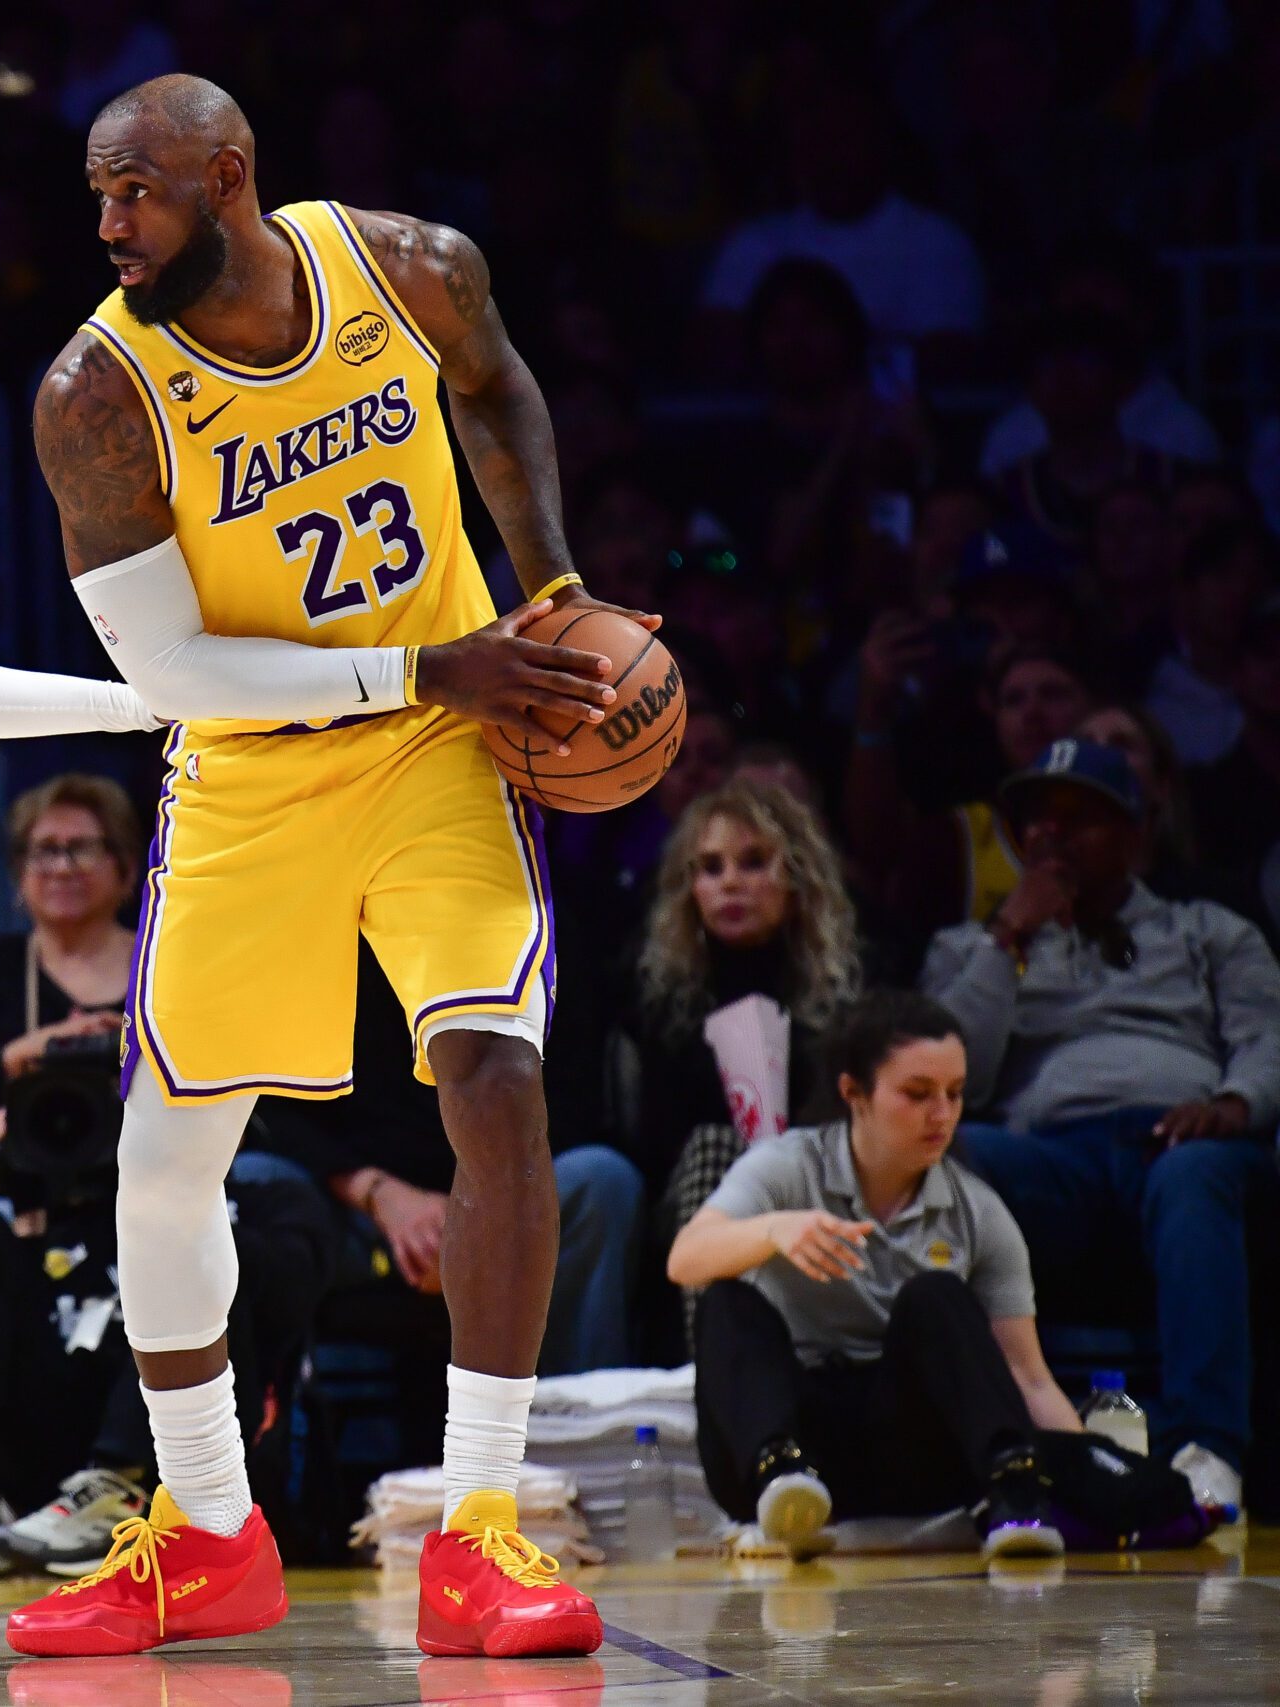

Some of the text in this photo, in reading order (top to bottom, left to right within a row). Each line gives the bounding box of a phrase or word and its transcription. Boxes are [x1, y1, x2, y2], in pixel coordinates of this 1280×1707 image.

[339, 322, 384, 355] bibigo
[209, 375, 418, 527] LAKERS
[273, 477, 431, 629] 23
[592, 661, 681, 753] Wilson
